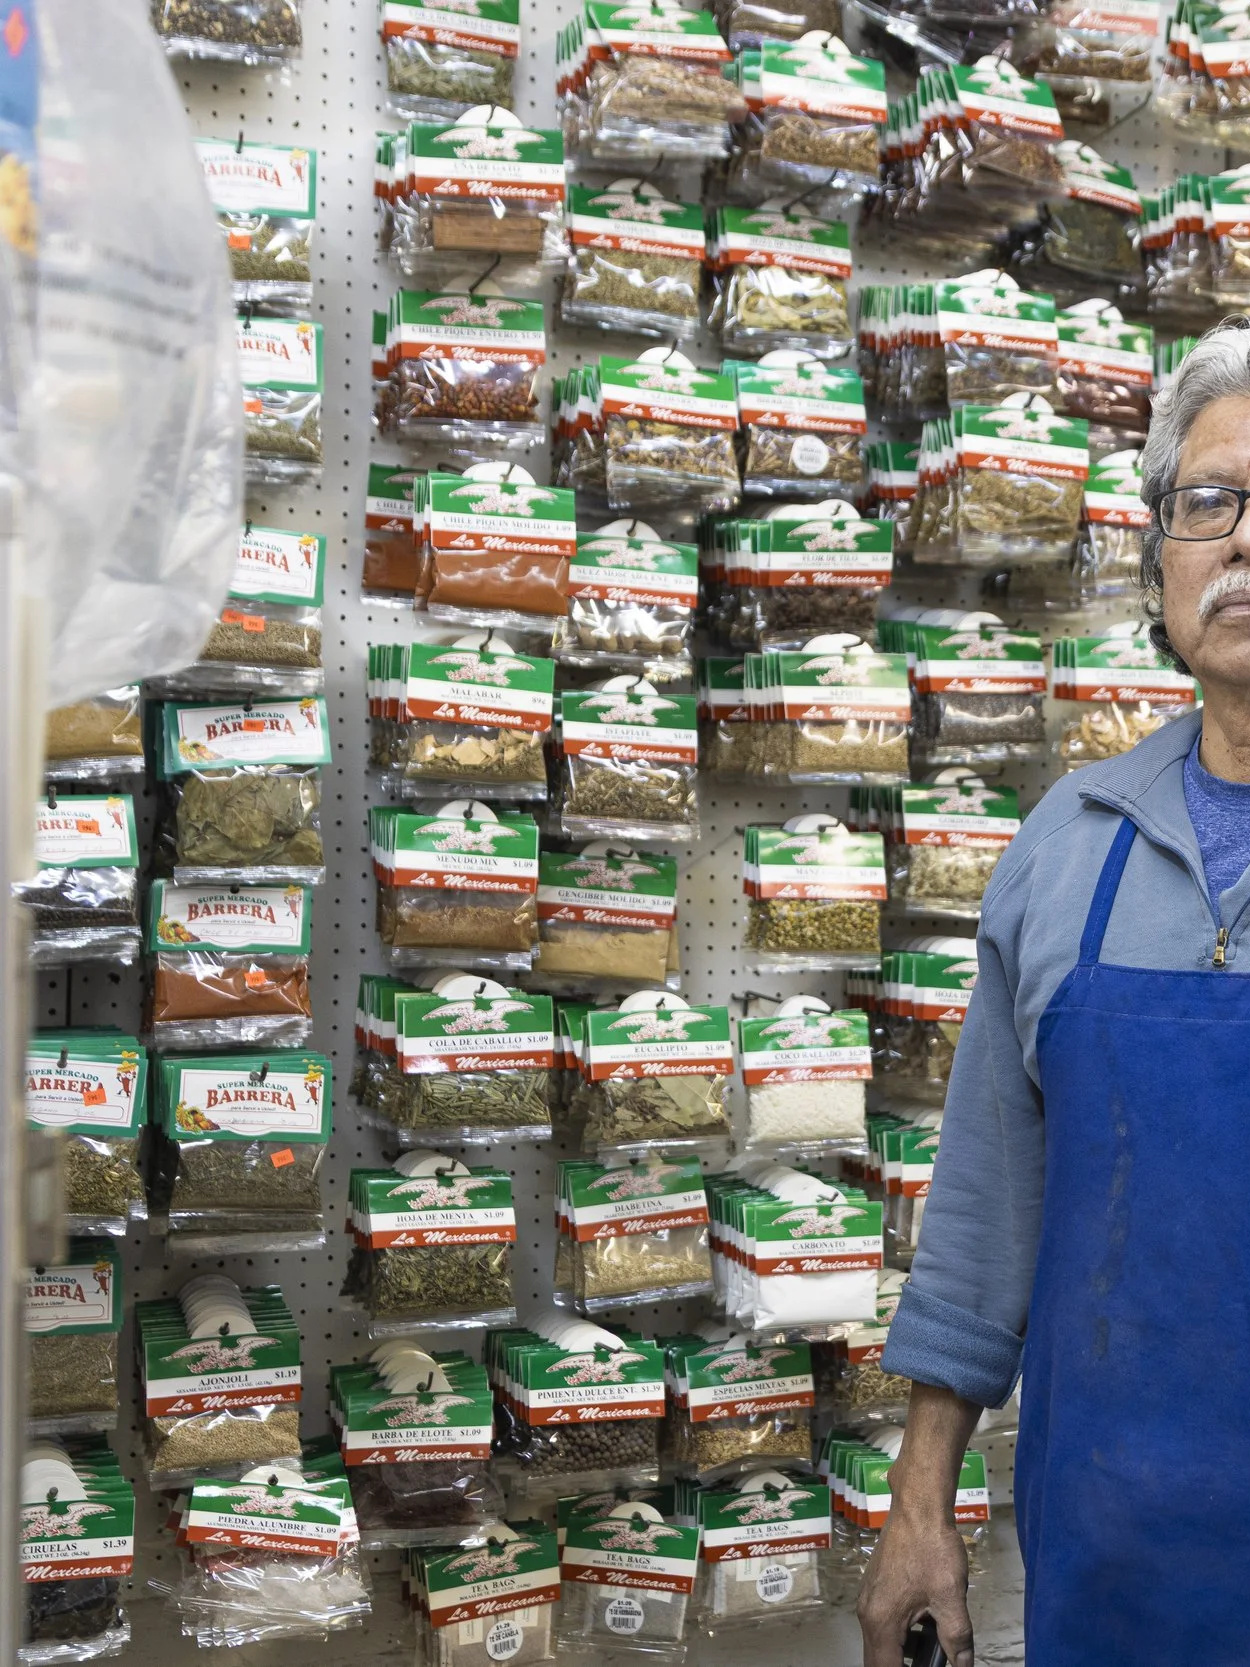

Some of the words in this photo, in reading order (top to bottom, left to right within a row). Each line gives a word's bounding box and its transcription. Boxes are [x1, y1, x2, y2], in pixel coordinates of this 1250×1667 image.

[411, 325, 447, 336] CHILE
[449, 327, 478, 337] PIQUIN
[481, 328, 518, 338] ENTERO
[418, 344, 446, 360] La
[451, 346, 528, 362] Mexicana
[442, 514, 472, 525] CHILE
[475, 517, 507, 527] PIQUIN
[511, 519, 552, 530] MOLIDO
[450, 534, 475, 547] La
[482, 535, 560, 554] Mexicana
[785, 573, 807, 584] La
[814, 573, 877, 585] Mexicana
[214, 713, 242, 723] SUPER
[243, 711, 285, 720] MERCADO
[432, 703, 456, 719] La
[459, 705, 522, 725] Mexicana
[579, 742, 604, 756] La
[609, 743, 681, 760] Mexicana
[436, 853, 478, 865] MENUDO
[479, 856, 498, 866] MIX
[512, 859, 534, 869] $1.09
[410, 872, 437, 886] La
[443, 874, 519, 891] Mexicana
[197, 895, 224, 904] SUPER
[226, 895, 268, 906] MERCADO
[558, 889, 603, 900] GENGIBRE
[605, 892, 647, 904] MOLIDO
[187, 903, 276, 924] BARRERA
[551, 907, 576, 920] La
[582, 909, 655, 927] Mexicana
[475, 1037, 522, 1045] CABALLO
[527, 1035, 549, 1043] $1.09
[634, 1044, 688, 1054] EUCALIPTO
[705, 1044, 725, 1052] $1.09
[455, 1056, 536, 1069] Mexicana
[609, 1064, 634, 1077] La
[641, 1062, 715, 1076] Mexicana
[248, 1080, 288, 1092] MERCADO
[206, 1088, 296, 1112] BARRERA
[614, 1199, 663, 1213] DIABETINA
[682, 1193, 702, 1203] $1.09
[396, 1214, 422, 1222] HOJA
[441, 1212, 474, 1220] MENTA
[594, 1223, 617, 1236] La
[624, 1213, 693, 1233] Mexicana
[390, 1233, 416, 1245] La
[423, 1231, 499, 1243] Mexicana
[792, 1240, 846, 1250] CARBONATO
[771, 1260, 795, 1273] La
[801, 1258, 869, 1272] Mexicana
[34, 1274, 77, 1285] MERCADO
[199, 1375, 248, 1386] AJONJOLI
[275, 1371, 297, 1379] $1.19
[537, 1391, 583, 1399] PIMIENTA
[584, 1387, 615, 1396] DULCE
[713, 1383, 753, 1396] ESPECIAS
[755, 1380, 786, 1391] MIXTAS
[166, 1399, 194, 1412] La
[201, 1392, 282, 1409] Mexicana
[706, 1406, 730, 1419] La
[734, 1399, 800, 1414] Mexicana
[546, 1409, 570, 1422] La
[577, 1407, 650, 1419] Mexicana
[372, 1432, 403, 1440] BARBA
[421, 1429, 452, 1437] ELOTE
[362, 1451, 388, 1463] La
[394, 1449, 472, 1461] Mexicana
[218, 1515, 254, 1526] PIEDRA
[259, 1522, 307, 1531] ALUMBRE
[746, 1527, 762, 1535] TEA
[766, 1524, 789, 1532] BAGS
[23, 1543, 77, 1554] CIRUELAS
[103, 1539, 127, 1548] $1.39
[205, 1531, 232, 1543] La
[239, 1534, 321, 1552] Mexicana
[606, 1553, 623, 1562] TEA
[627, 1556, 651, 1564] BAGS
[719, 1547, 742, 1560] La
[748, 1542, 816, 1556] Mexicana
[25, 1565, 112, 1579] Mexicana
[576, 1569, 599, 1581] La
[606, 1571, 675, 1589] Mexicana
[471, 1585, 489, 1593] TEA
[492, 1578, 516, 1589] BAGS
[447, 1608, 470, 1621] La
[475, 1594, 544, 1615] Mexicana
